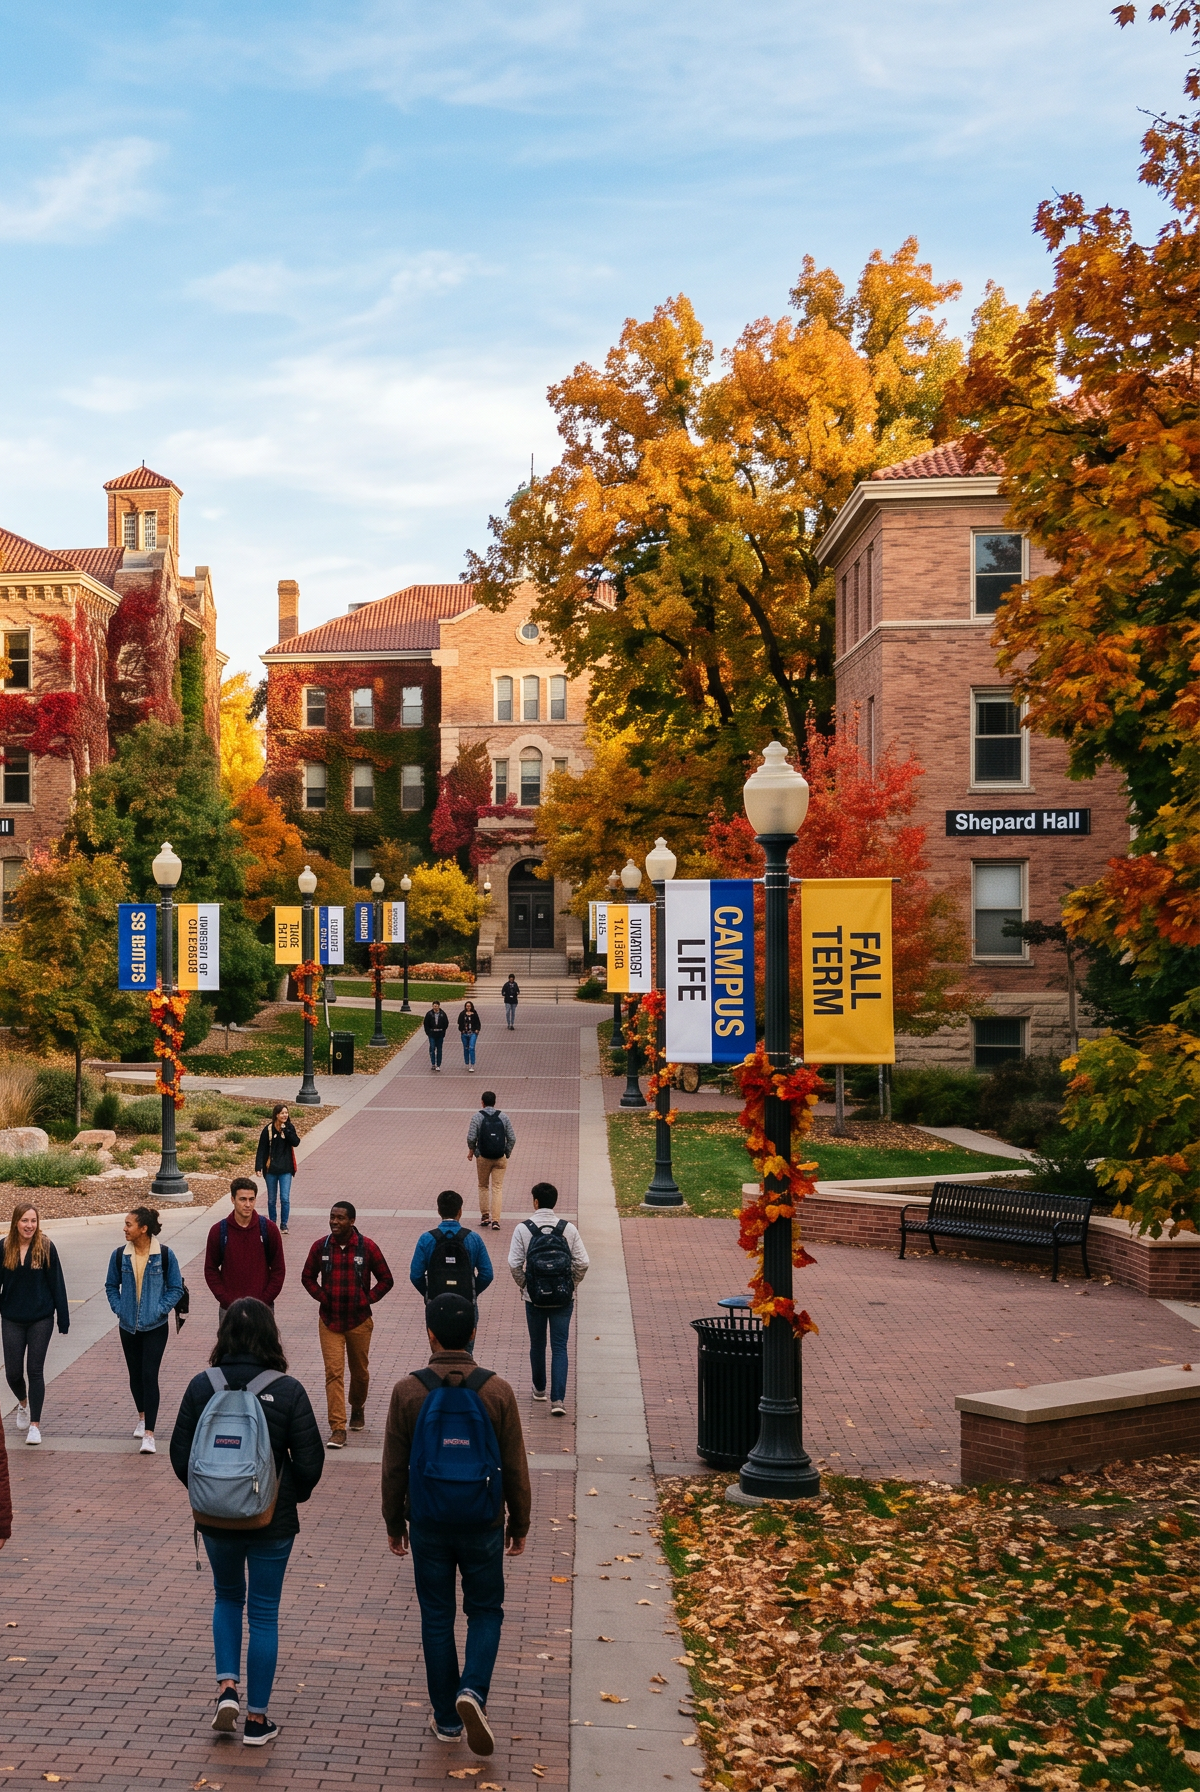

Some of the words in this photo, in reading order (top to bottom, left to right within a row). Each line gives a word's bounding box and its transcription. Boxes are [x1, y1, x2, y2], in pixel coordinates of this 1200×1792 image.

[955, 812, 1036, 834] Shepard
[1043, 811, 1080, 829] Hall
[677, 939, 707, 1001] LIFE
[713, 905, 745, 1037] CAMPUS
[812, 925, 844, 1015] TERM
[849, 932, 882, 1010] FALL
